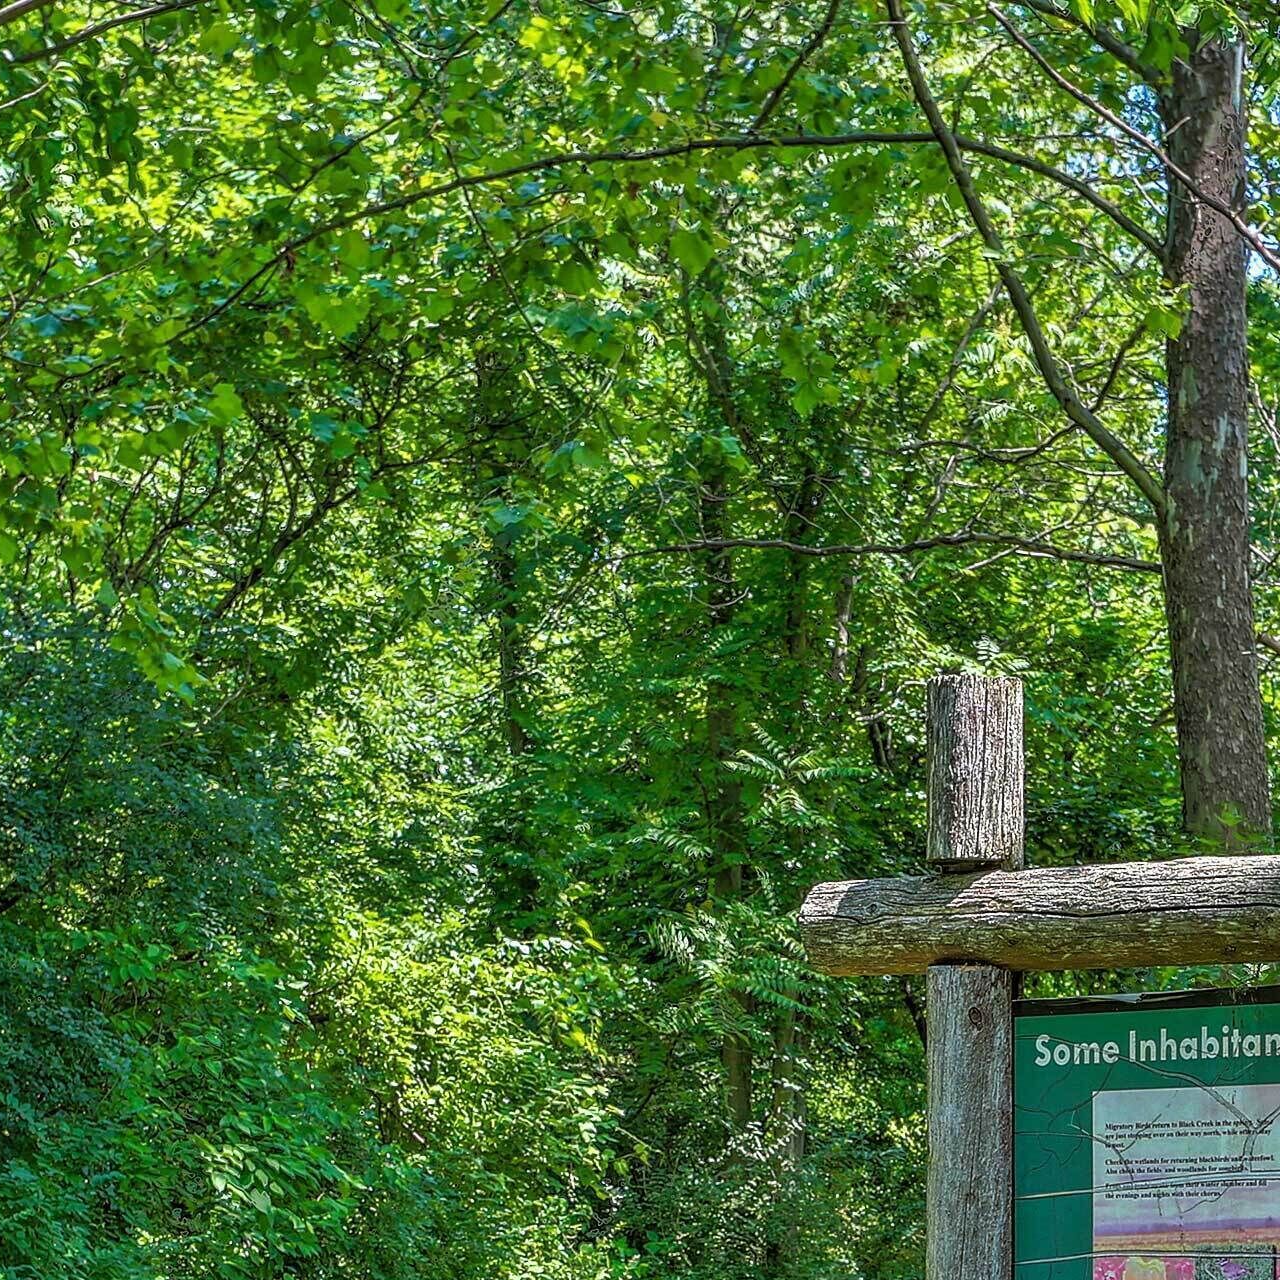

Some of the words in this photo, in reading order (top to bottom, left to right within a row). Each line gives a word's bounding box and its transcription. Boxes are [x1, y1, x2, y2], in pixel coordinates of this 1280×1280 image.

[1034, 1034, 1120, 1067] Some
[1105, 1122, 1134, 1131] Migratory
[1179, 1120, 1195, 1128] Black
[1196, 1119, 1214, 1127] Creek
[1222, 1119, 1232, 1127] the
